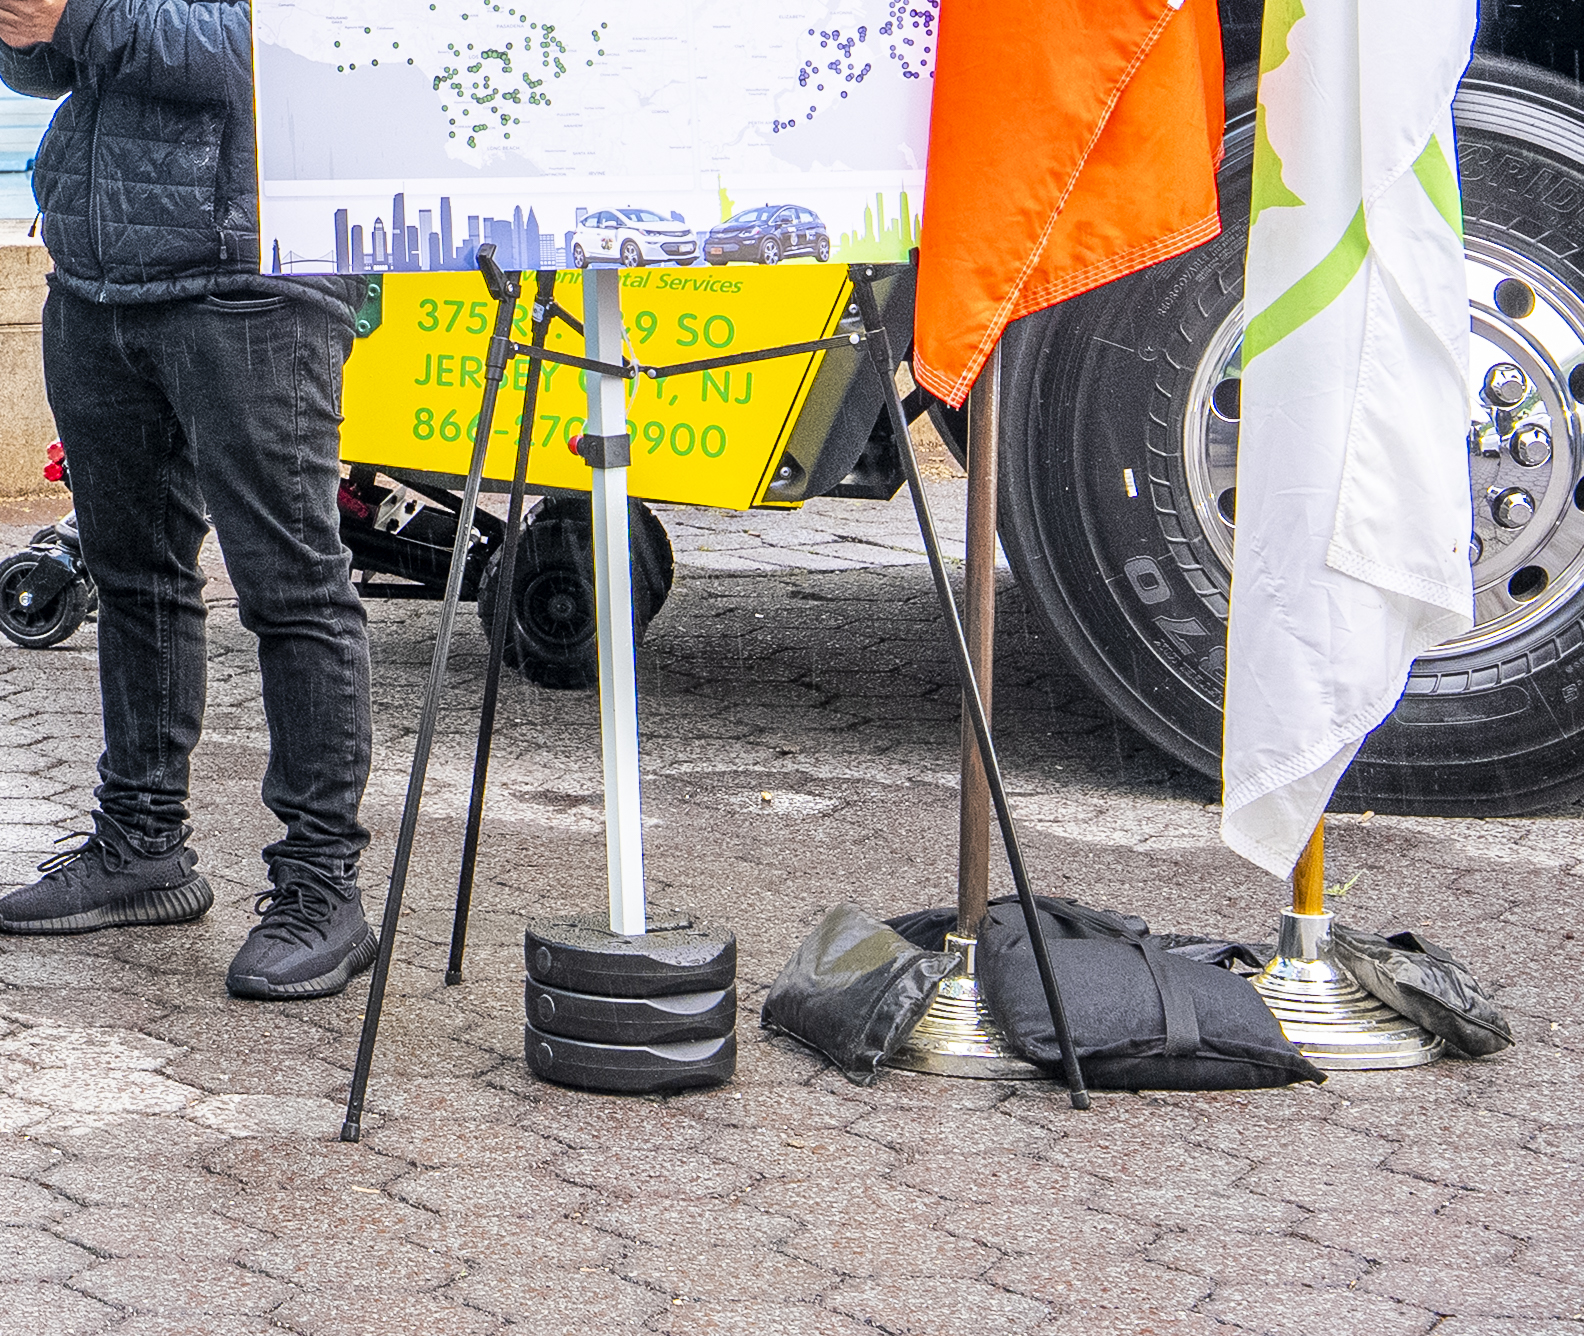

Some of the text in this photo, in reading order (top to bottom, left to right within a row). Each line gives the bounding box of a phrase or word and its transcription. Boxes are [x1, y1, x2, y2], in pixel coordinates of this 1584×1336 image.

[657, 273, 743, 294] Services
[418, 299, 487, 334] 375
[676, 313, 735, 349] SO
[702, 369, 752, 405] NJ
